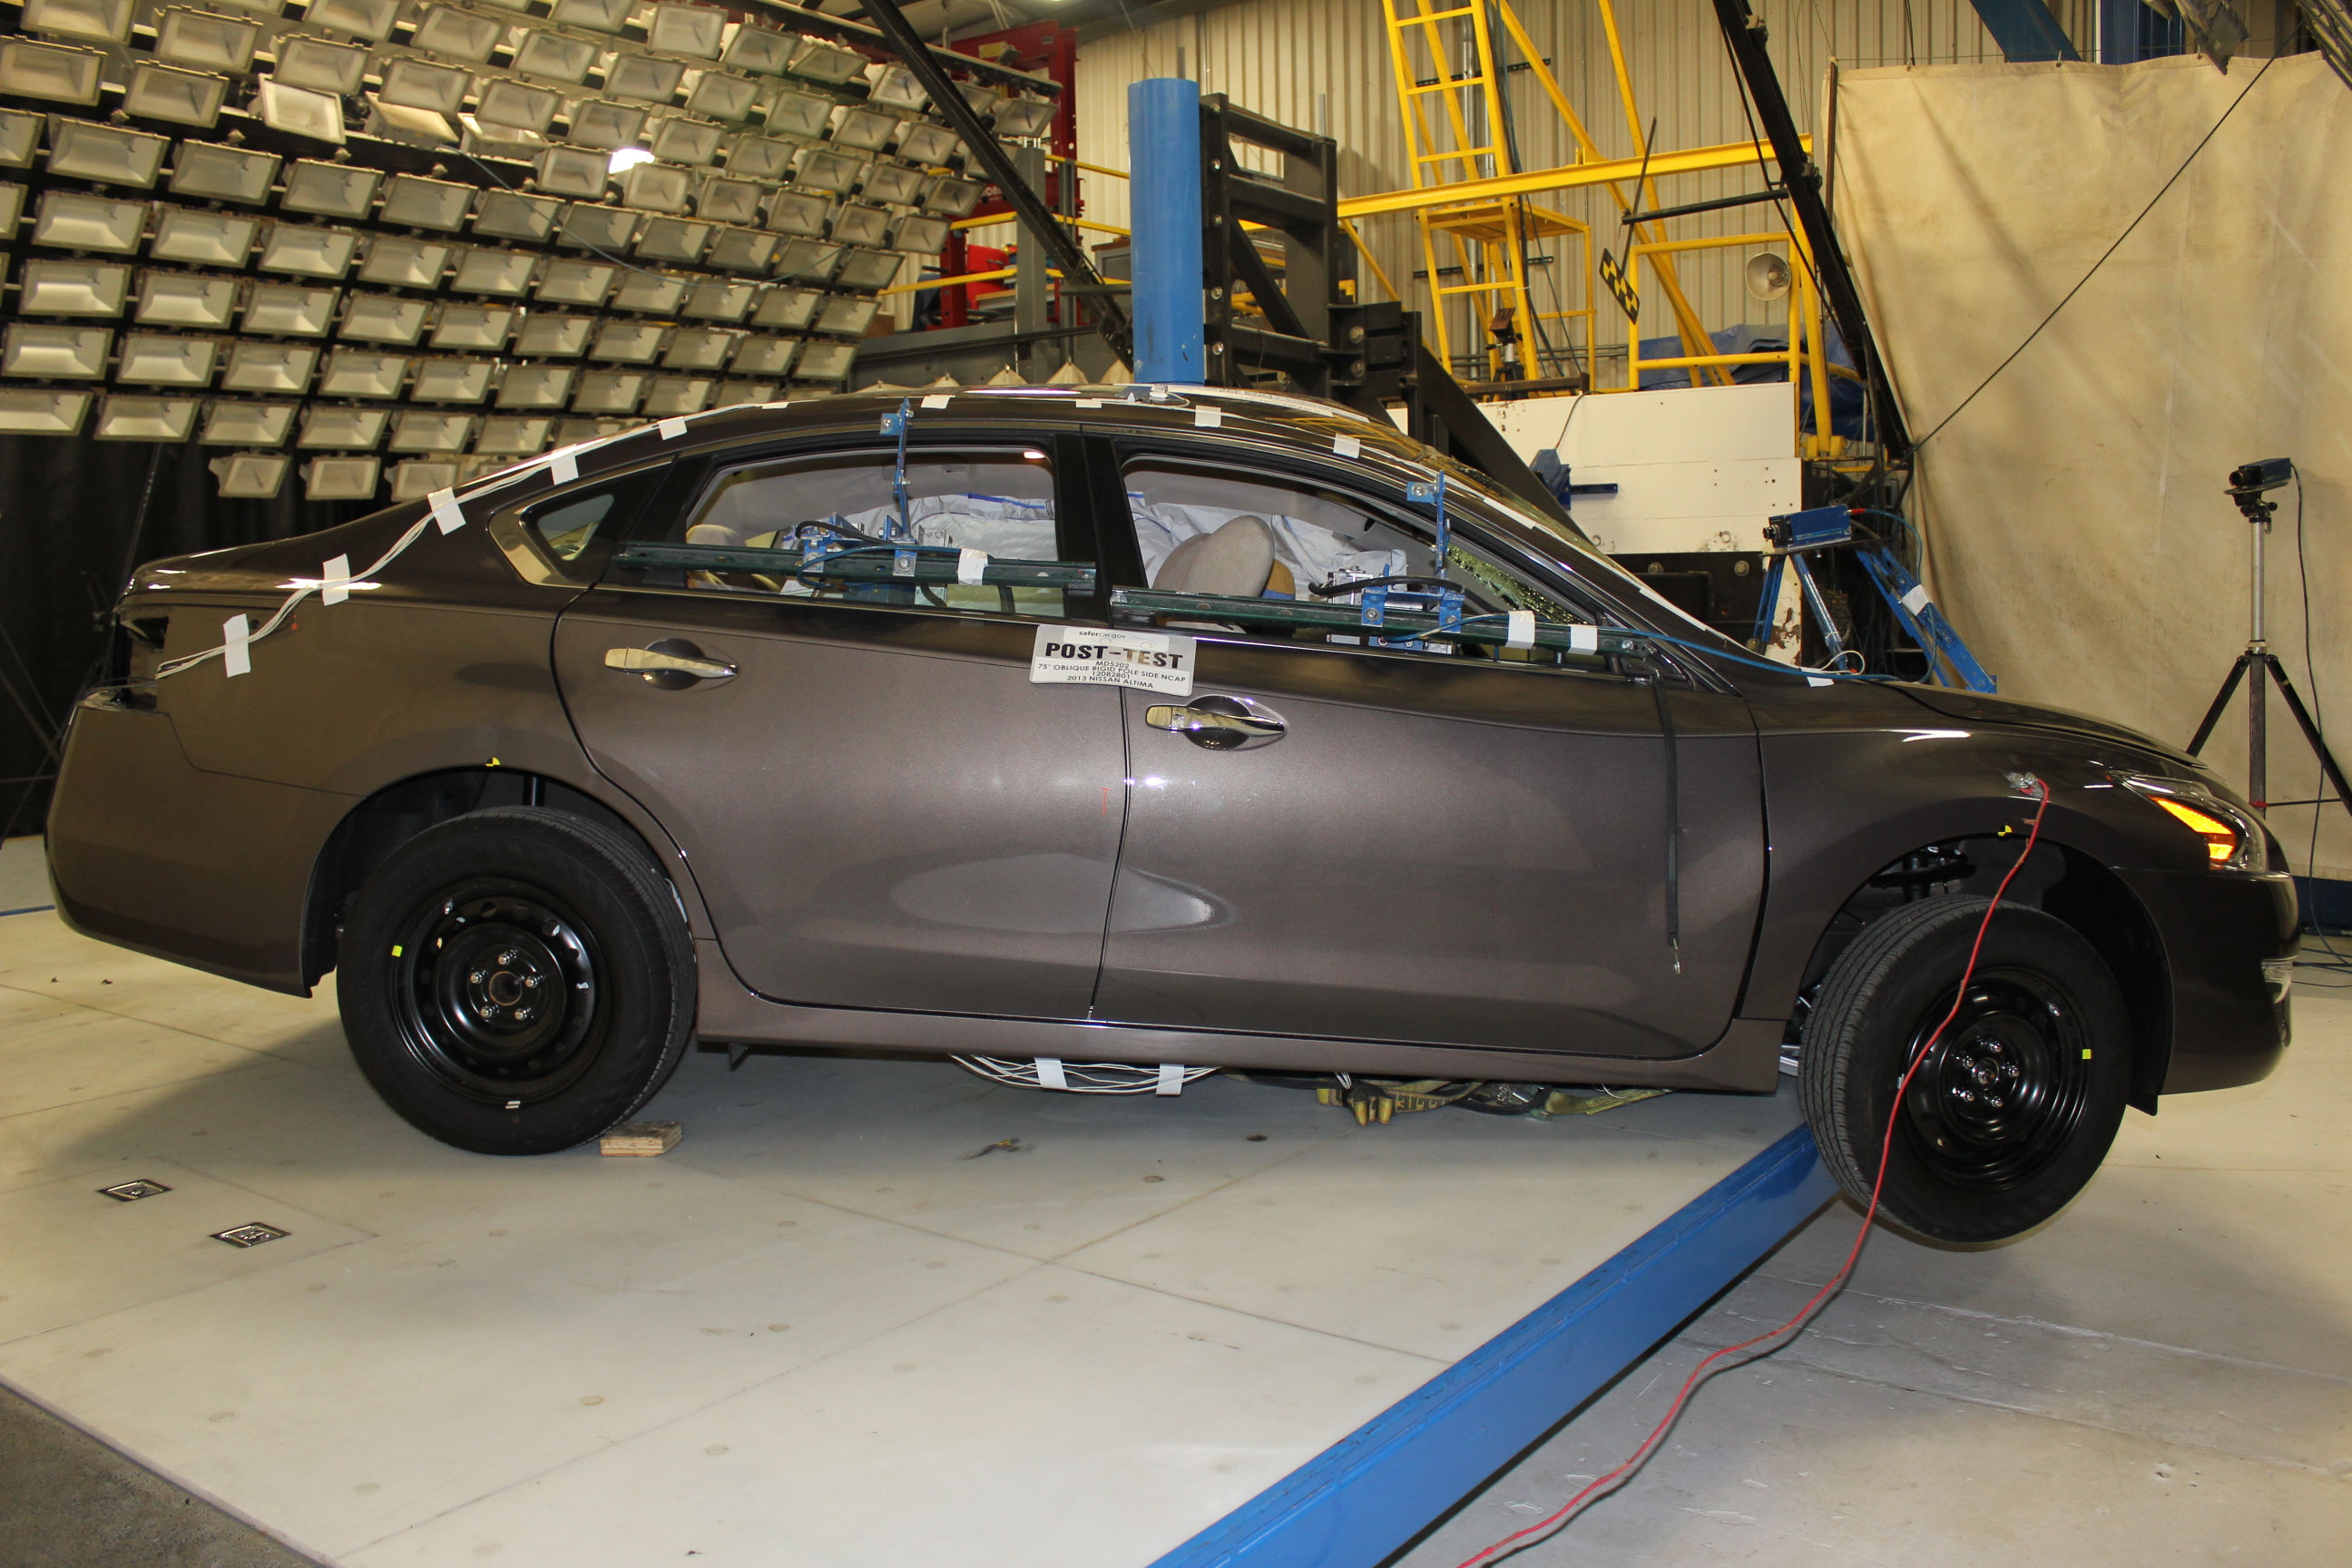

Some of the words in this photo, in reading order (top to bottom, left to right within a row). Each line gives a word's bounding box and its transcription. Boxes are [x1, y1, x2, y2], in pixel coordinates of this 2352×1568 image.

[1079, 631, 1126, 639] safercar.gov
[1045, 642, 1183, 669] POST-TEST
[1095, 661, 1130, 669] MD5202
[1093, 671, 1130, 680] 12082801
[1118, 667, 1139, 675] POLE
[1141, 671, 1159, 679] SIDE
[1161, 673, 1186, 682] NCAP
[1123, 679, 1153, 689] ALTIMA
